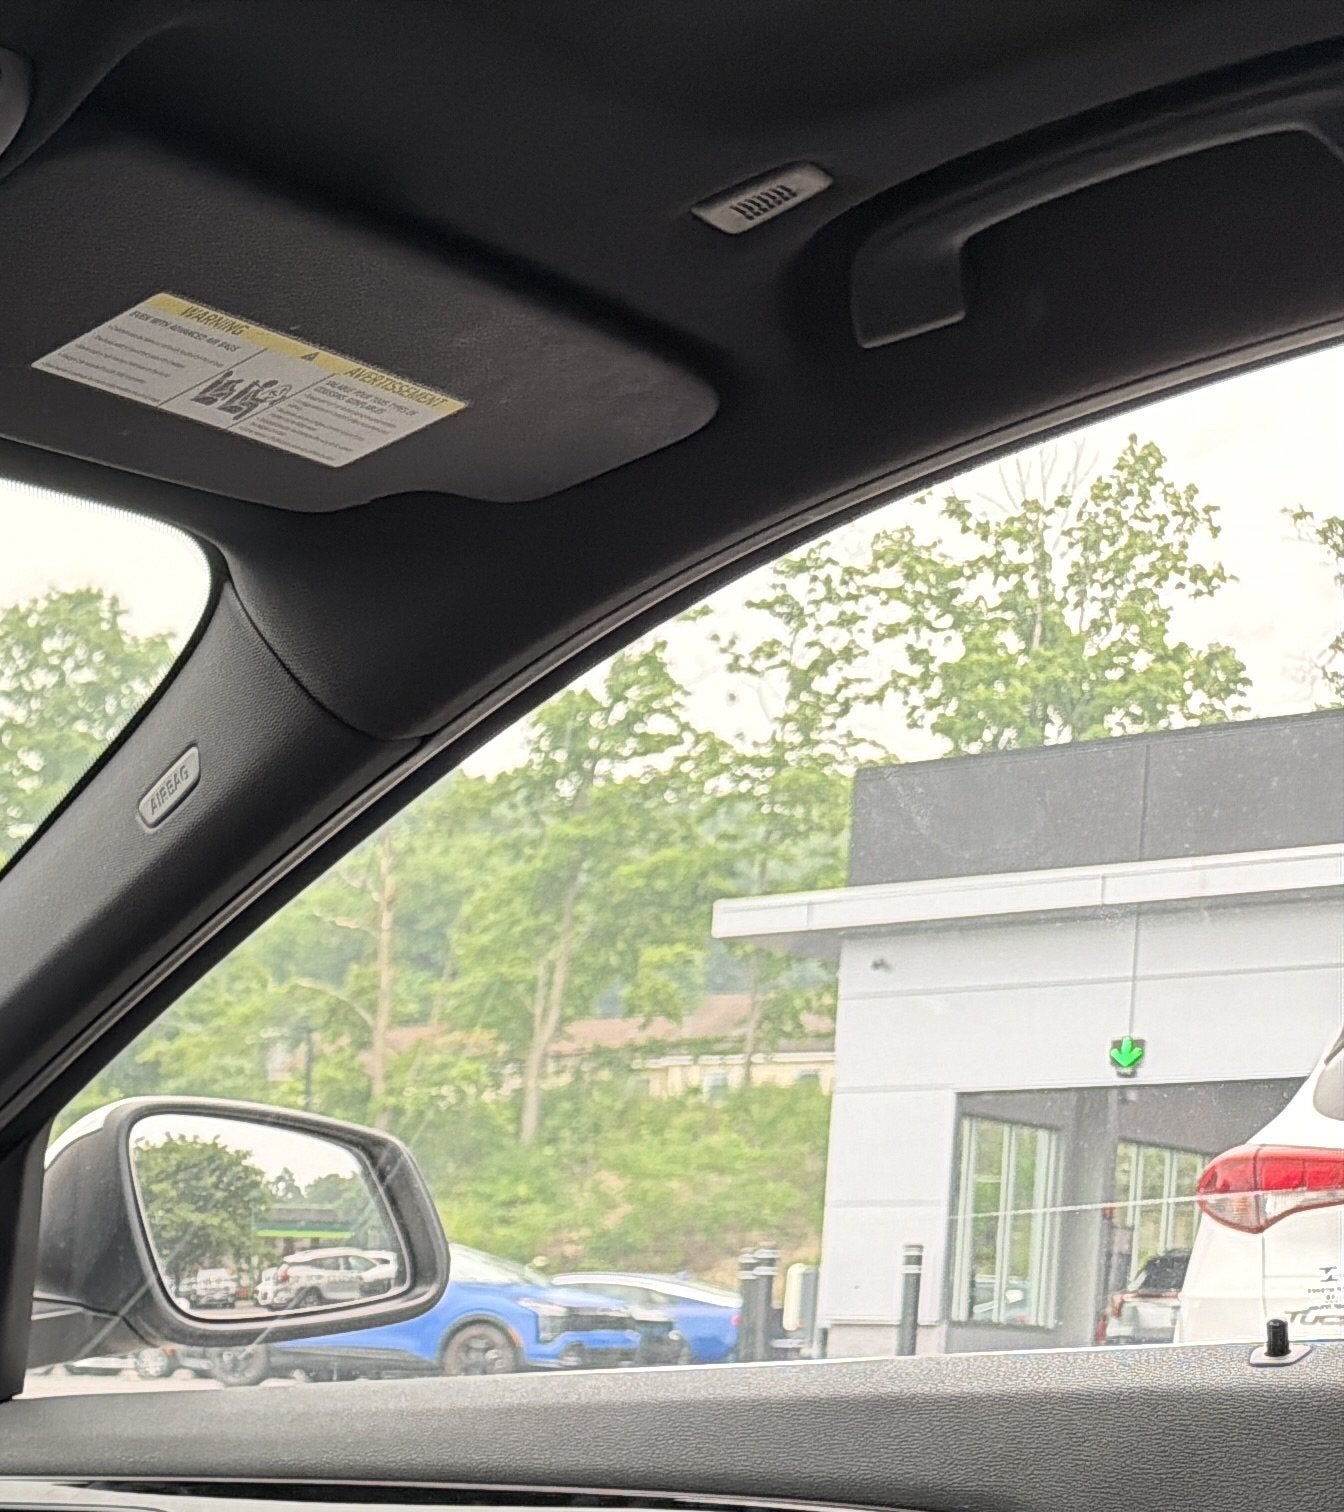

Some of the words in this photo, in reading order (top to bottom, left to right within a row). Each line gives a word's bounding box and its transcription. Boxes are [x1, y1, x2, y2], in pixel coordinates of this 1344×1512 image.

[180, 305, 251, 336] WARNING
[343, 367, 450, 408] AVERTISSEMENT
[149, 764, 190, 816] AIRBAG
[1284, 1310, 1344, 1326] TUC
